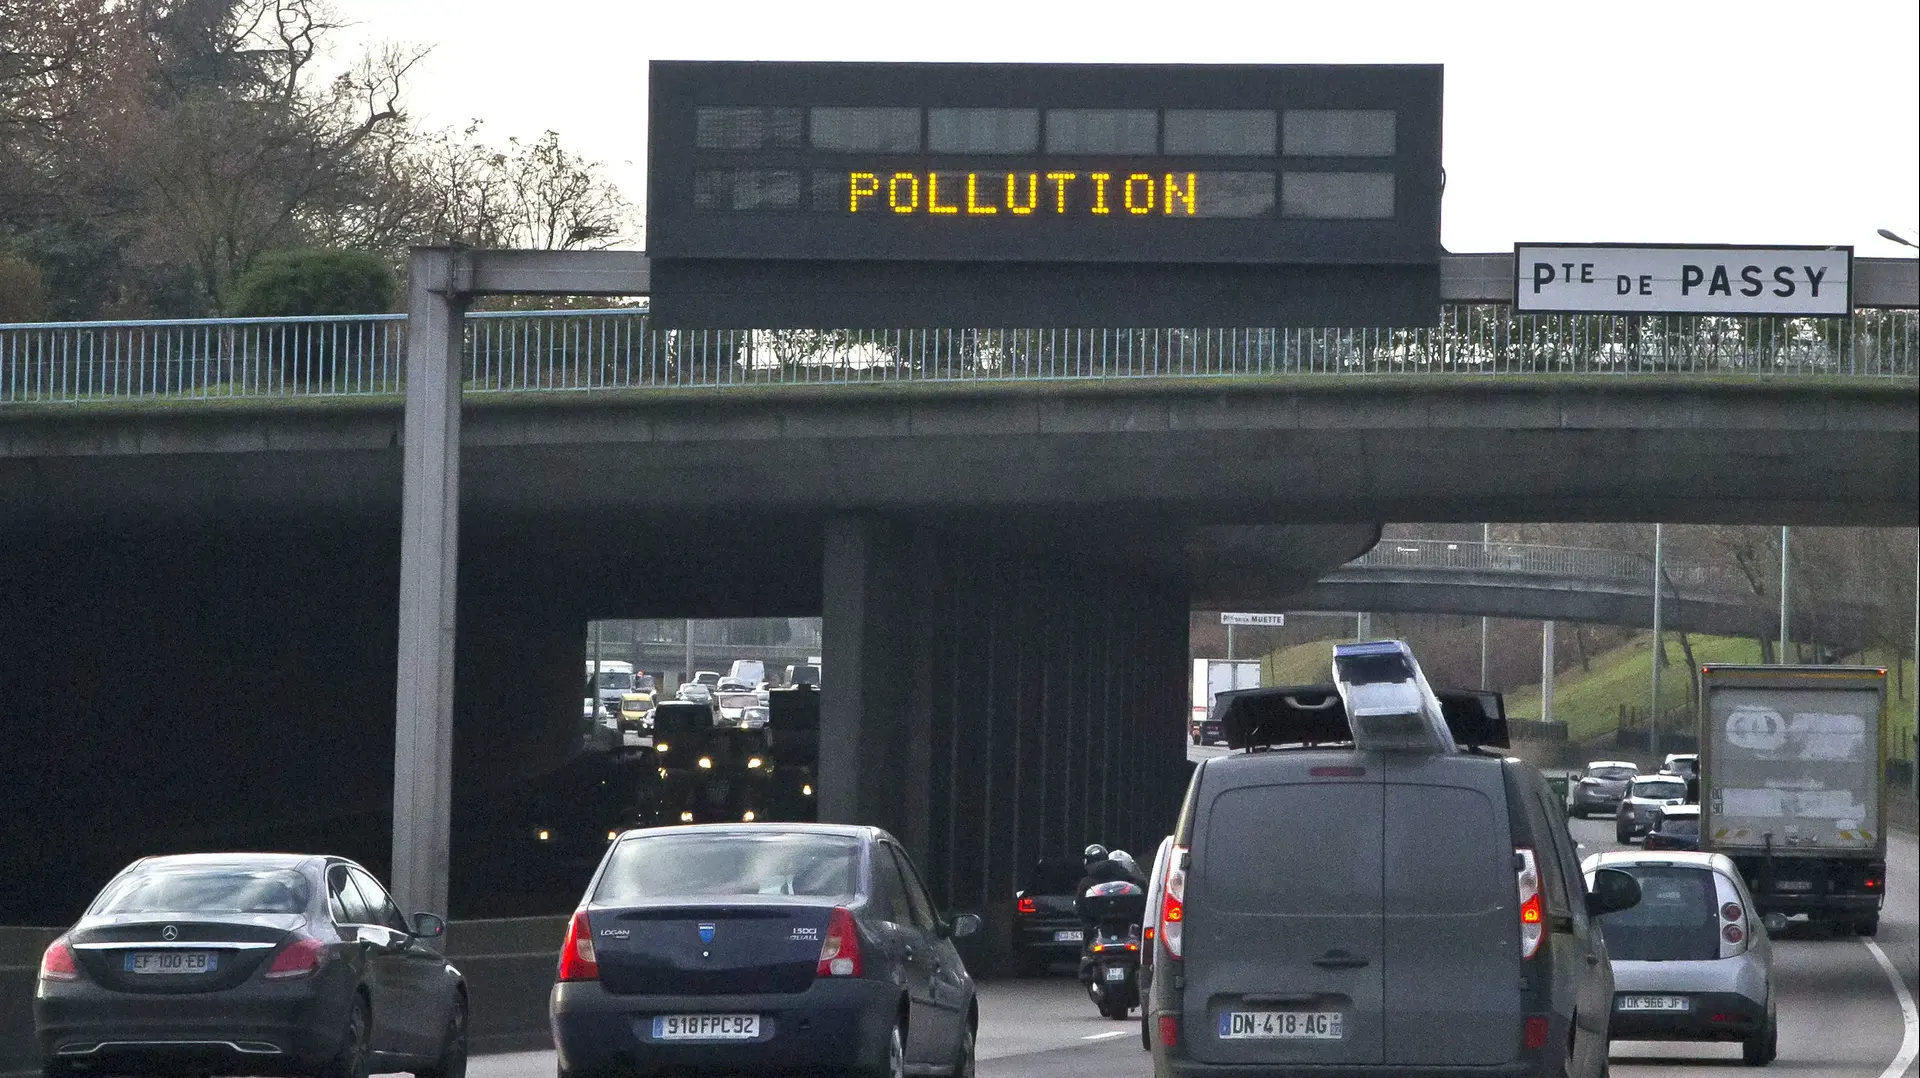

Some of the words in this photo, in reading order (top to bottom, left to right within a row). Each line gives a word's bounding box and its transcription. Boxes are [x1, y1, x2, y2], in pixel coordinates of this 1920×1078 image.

[850, 172, 1196, 215] POLLUTION
[1616, 275, 1652, 295] DE
[1681, 264, 1828, 298] PASSY
[1251, 615, 1282, 623] MUETTE
[1232, 1014, 1327, 1034] DN-418-AG
